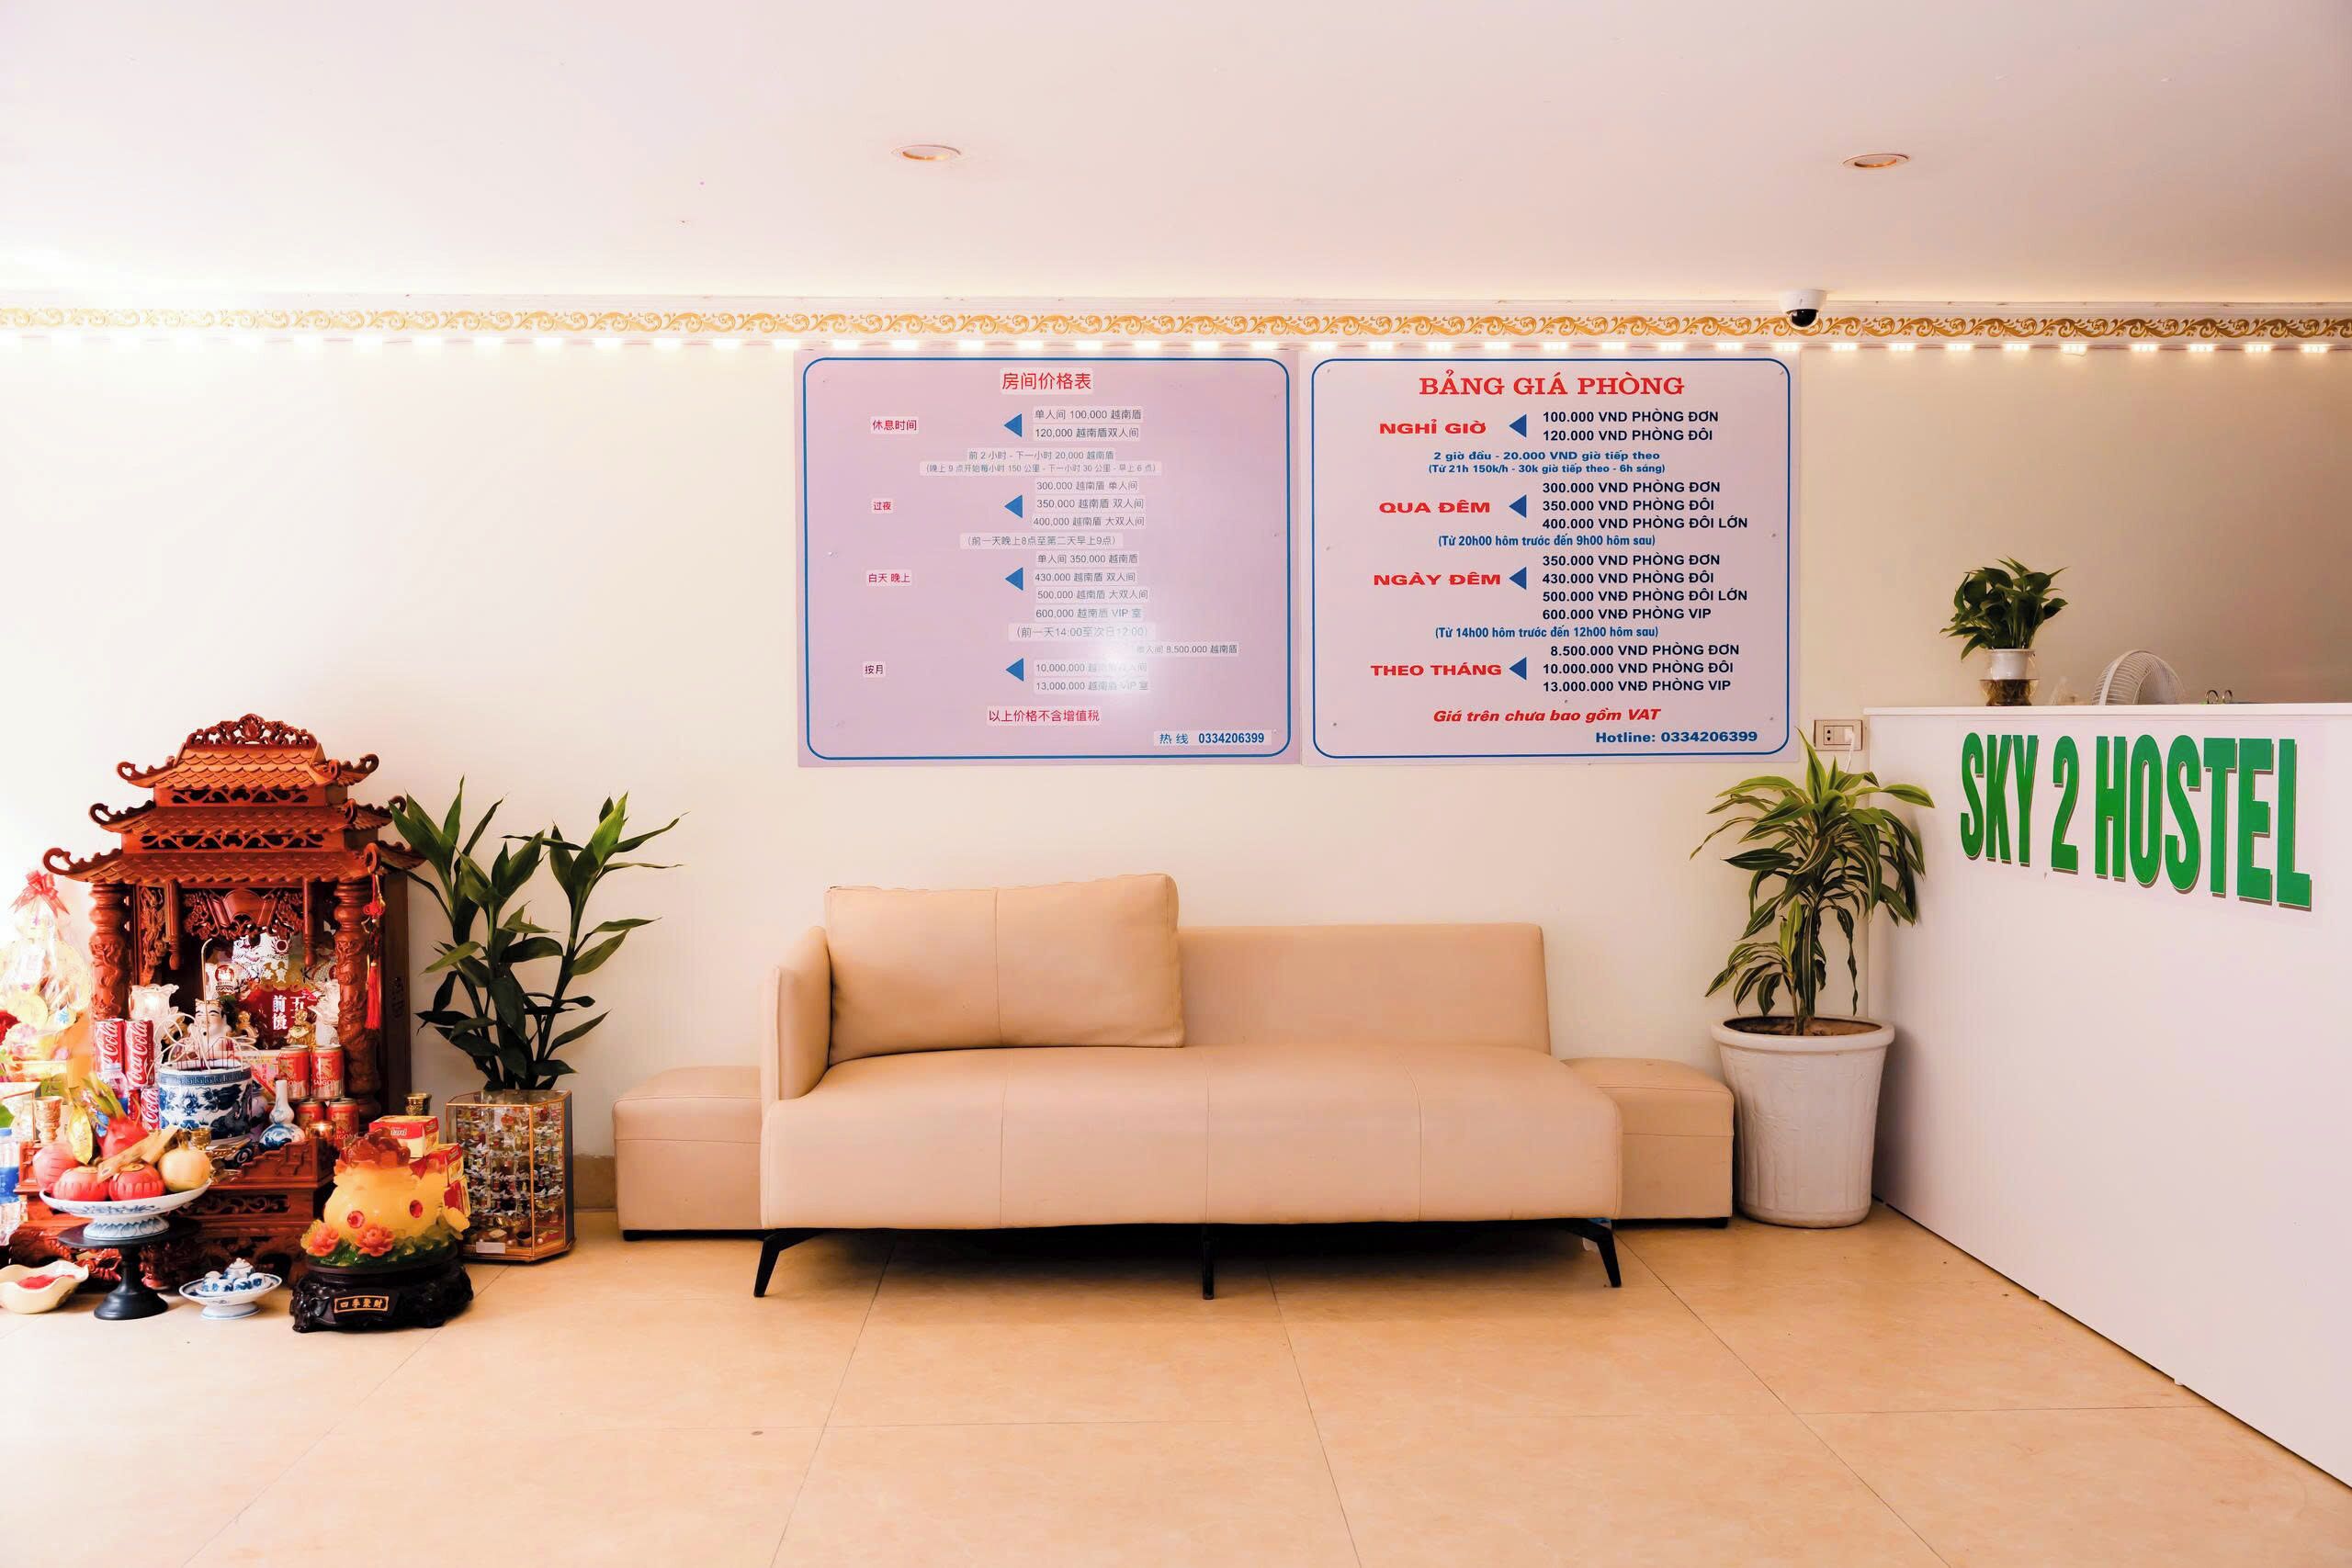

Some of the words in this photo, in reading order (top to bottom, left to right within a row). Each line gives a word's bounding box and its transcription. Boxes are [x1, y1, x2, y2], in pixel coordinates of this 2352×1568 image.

[1001, 371, 1092, 390] 房间价格表
[1418, 368, 1506, 396] BẢNG
[1512, 370, 1569, 396] GIÁ
[1577, 370, 1686, 396] PHÒNG
[1543, 411, 1595, 423] 100.000
[1597, 411, 1628, 423] VND
[1632, 407, 1685, 423] PHÒNG
[1687, 410, 1719, 423] ĐƠN
[871, 419, 918, 432] 休息时间
[1379, 418, 1438, 435] NGHỈ
[1443, 419, 1487, 435] GIỜ
[1543, 429, 1595, 442] 120.000
[1598, 429, 1628, 442] VND
[1631, 425, 1685, 442] PHÒNG
[1687, 426, 1713, 442] ĐÔI
[1432, 451, 1442, 461] 2
[1444, 450, 1465, 463] giờ
[1468, 449, 1492, 461] đầu
[1502, 451, 1546, 461] 20.000
[1549, 450, 1578, 461] VND
[1580, 450, 1602, 463] giờ
[1603, 449, 1630, 463] tiếp
[1632, 450, 1661, 460] theo
[1428, 463, 1447, 475] (Từ
[1448, 464, 1470, 474] 21h
[1472, 464, 1510, 474] 150k/h
[1518, 463, 1539, 474] 30k
[1541, 463, 1559, 476] giờ
[1561, 462, 1583, 475] tiếp
[1585, 463, 1611, 473] theo
[1619, 463, 1634, 473] 6h
[1635, 463, 1666, 475] sáng)
[1542, 481, 1595, 494] 300.000
[1597, 481, 1629, 493] VND
[1632, 479, 1686, 493] PHÒNG
[1688, 480, 1721, 493] ĐƠN
[873, 501, 892, 512] 过夜
[1378, 502, 1432, 514] QUA
[1437, 498, 1491, 514] ĐÊM
[1542, 500, 1595, 512] 350.000
[1597, 500, 1629, 512] VND
[1632, 496, 1686, 512] PHÒNG
[1688, 496, 1714, 512] ĐÔI
[1541, 517, 1595, 530] 400.000
[1597, 517, 1629, 530] VND
[1632, 514, 1685, 530] PHÒNG
[1688, 514, 1714, 529] ĐÔI
[1718, 513, 1748, 529] LỚN
[1438, 535, 1457, 547] (Từ
[1457, 535, 1493, 547] 20h00
[1495, 535, 1520, 547] hôm
[1521, 534, 1551, 547] trước
[1553, 532, 1574, 547] đến
[1576, 534, 1604, 547] 9h00
[1606, 534, 1631, 547] hôm
[1632, 534, 1657, 547] sau)
[1542, 554, 1595, 567] 350.000
[1597, 554, 1629, 567] VND
[1632, 551, 1685, 567] PHÒNG
[1688, 553, 1721, 566] ĐƠN
[1373, 570, 1442, 587] NGÀY
[1447, 570, 1501, 586] ĐÊM
[1541, 572, 1595, 585] 430.000
[1597, 572, 1629, 584] VND
[1632, 569, 1685, 584] PHÒNG
[1688, 569, 1714, 584] ĐÔI
[1542, 590, 1595, 603] 500.000
[1597, 590, 1629, 603] VNĐ
[1632, 587, 1685, 602] PHÒNG
[1687, 587, 1714, 602] ĐÔI
[1717, 586, 1748, 602] LỚN
[1542, 608, 1595, 621] 600.000
[1597, 608, 1629, 620] VNĐ
[1632, 604, 1685, 620] PHÒNG
[1687, 607, 1713, 620] VIP
[1434, 626, 1454, 639] (Từ
[1455, 626, 1489, 638] 14h00
[1491, 626, 1516, 638] hôm
[1518, 626, 1548, 638] trước
[1549, 624, 1570, 638] đến
[1573, 626, 1607, 637] 12h00
[1609, 626, 1634, 637] hôm
[1635, 626, 1659, 638] sau)
[1550, 644, 1614, 657] 8.500.000
[1617, 644, 1648, 657] VND
[1652, 641, 1705, 656] PHÒNG
[1707, 642, 1740, 656] ĐƠN
[1369, 664, 1425, 677] THEO
[1429, 661, 1502, 677] THÁNG
[1543, 662, 1614, 675] 10.000.000
[1617, 662, 1648, 674] VND
[1652, 659, 1705, 674] PHÒNG
[1707, 659, 1734, 674] ĐÔI
[1543, 680, 1614, 693] 13.000.000
[1617, 680, 1648, 692] VNĐ
[1652, 676, 1705, 692] PHÒNG
[1707, 679, 1732, 692] VIP
[989, 708, 1101, 723] 以上价格不含增值税
[1432, 709, 1463, 723] Giá
[1466, 709, 1500, 723] trên
[1504, 709, 1546, 722] chưa
[1549, 708, 1582, 722] bao
[1584, 706, 1623, 725] gồm
[1627, 707, 1663, 721] VAT
[1197, 731, 1265, 745] 0334206399
[1595, 731, 1657, 744] Hotline:
[1660, 730, 1758, 743] 0334206399
[1961, 731, 2039, 867] SKY
[2051, 735, 2080, 874] 2
[2094, 734, 2312, 911] HOSTEL
